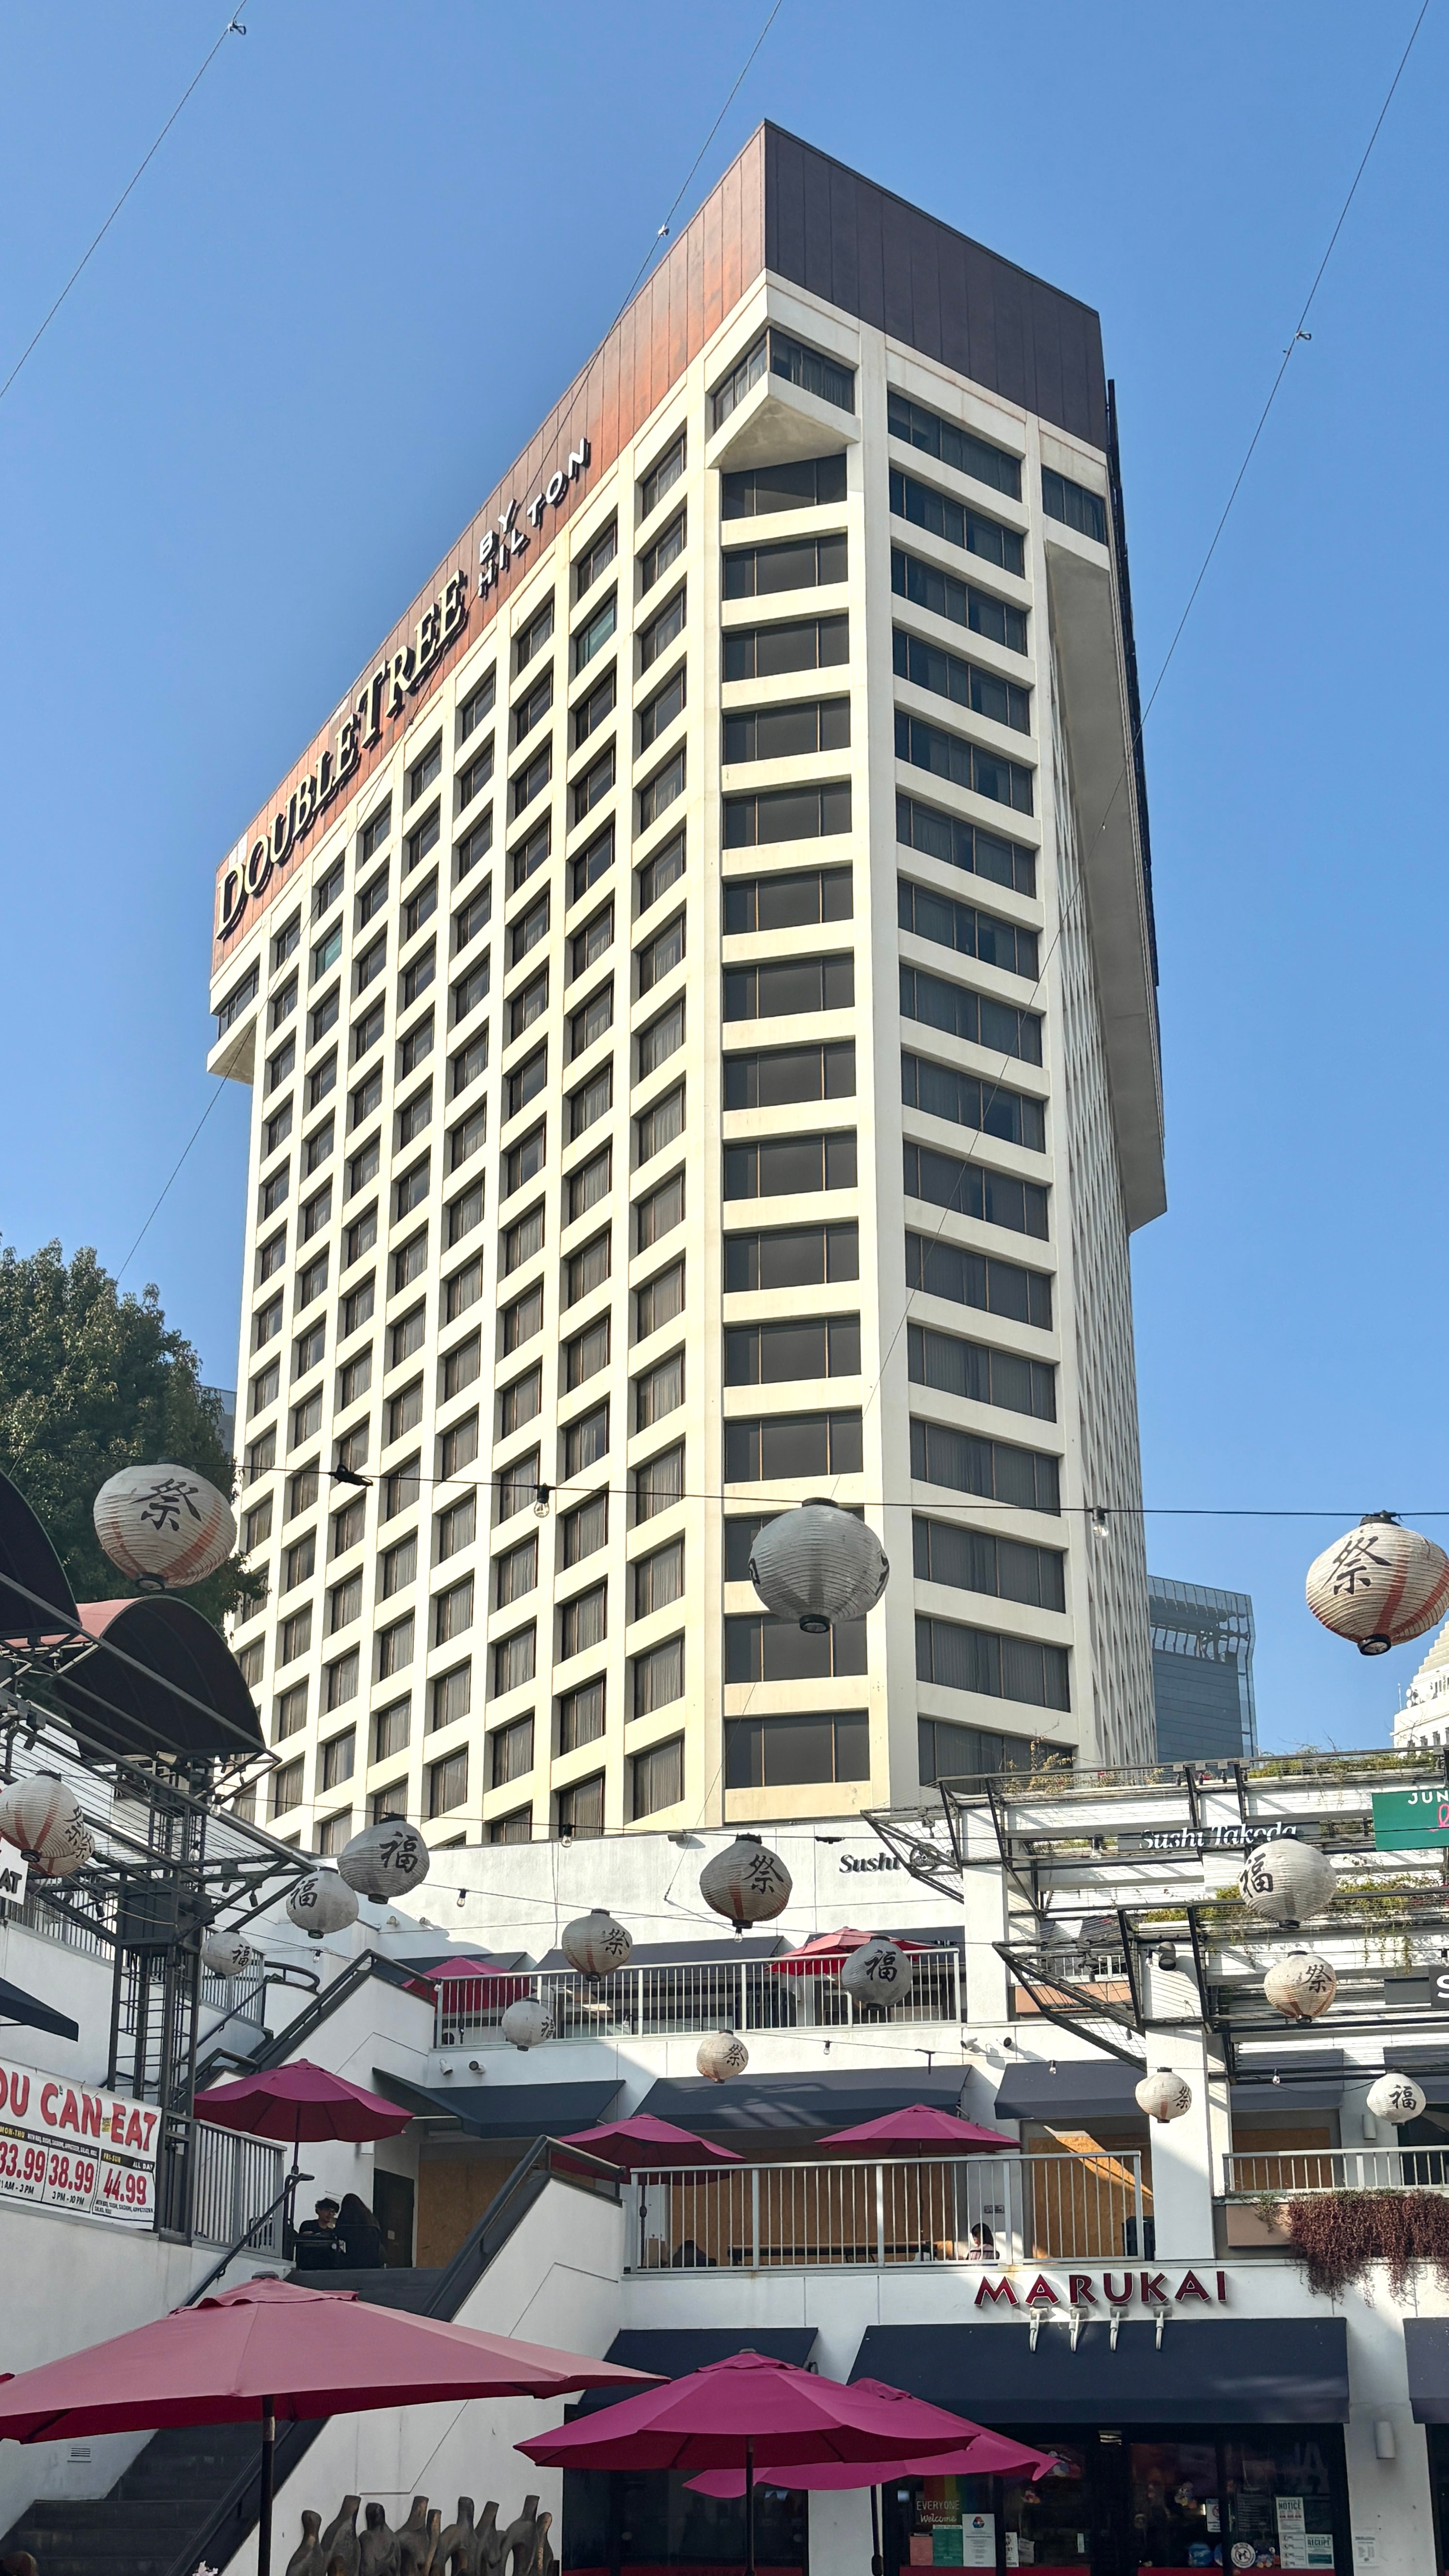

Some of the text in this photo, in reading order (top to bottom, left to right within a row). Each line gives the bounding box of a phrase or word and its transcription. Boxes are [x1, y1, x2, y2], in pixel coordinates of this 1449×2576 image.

[478, 438, 590, 601] HILTON
[479, 499, 521, 566] BY
[216, 569, 467, 940] DOUBLETREE
[129, 1478, 202, 1532] 祭
[1320, 1536, 1393, 1595] 祭
[379, 1831, 418, 1874] 福
[839, 1852, 901, 1874] Sushi
[742, 1853, 784, 1894] 祭
[1240, 1853, 1274, 1898] 福
[291, 1877, 318, 1909] 福
[232, 1943, 250, 1967] 福
[600, 1928, 630, 1956] 祭
[865, 1949, 898, 1982] 福
[1300, 1964, 1333, 1993] 祭
[723, 2044, 746, 2066] 祭
[1388, 2085, 1416, 2110] 福
[40, 2083, 102, 2138] CAN
[111, 2103, 157, 2152] EAT
[4, 2181, 15, 2190] AM
[19, 2184, 24, 2192] 3
[24, 2185, 34, 2195] PM
[49, 2154, 94, 2194] 38.99
[103, 2168, 147, 2205] 44.99
[52, 2191, 56, 2200] 3
[57, 2192, 65, 2201] PM
[70, 2195, 76, 2203] 10
[76, 2196, 84, 2206] PM
[974, 2269, 1228, 2307] MARUKAI
[916, 2500, 961, 2511] EVERYONE
[920, 2513, 958, 2523] Welcome
[1278, 2502, 1302, 2510] NOTICE
